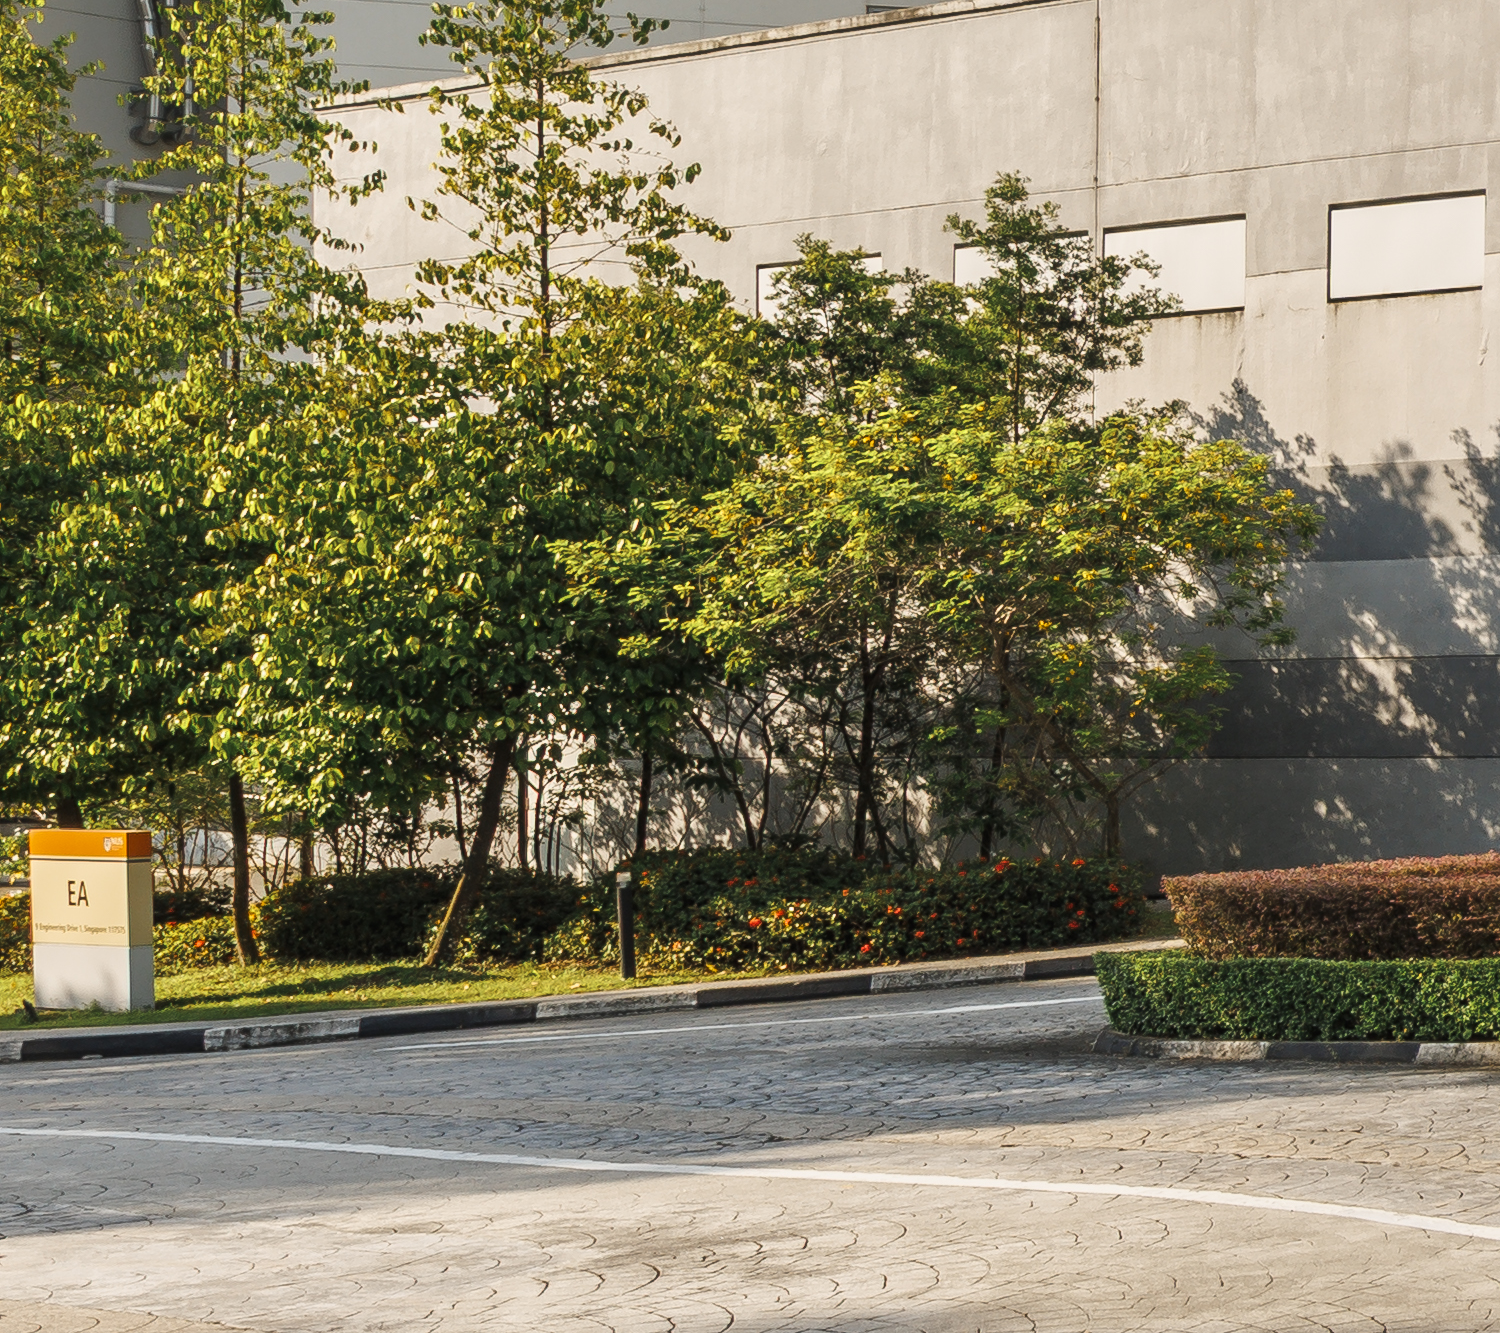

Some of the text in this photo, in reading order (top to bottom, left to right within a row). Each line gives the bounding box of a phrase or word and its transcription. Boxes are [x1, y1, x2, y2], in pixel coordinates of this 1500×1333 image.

[67, 880, 89, 907] EA
[39, 923, 66, 934] Engineering
[67, 924, 79, 932] Drive
[84, 925, 107, 935] Singapore
